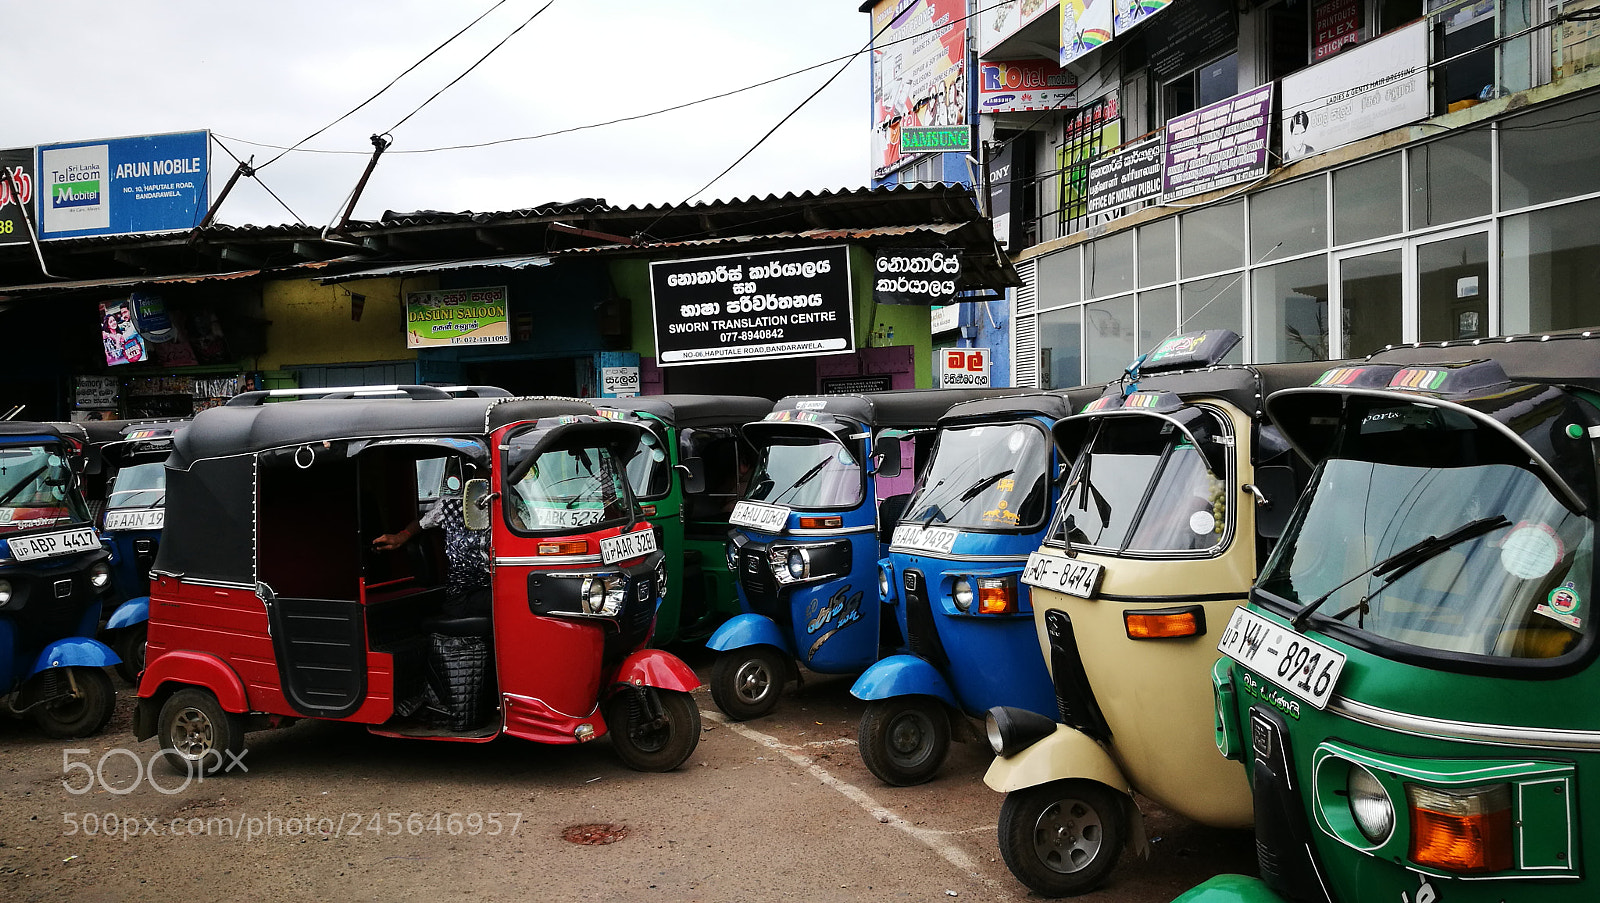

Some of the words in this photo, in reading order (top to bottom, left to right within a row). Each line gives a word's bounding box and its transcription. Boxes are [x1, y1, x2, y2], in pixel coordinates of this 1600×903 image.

[1317, 5, 1356, 30] PRINTOUTS
[1319, 19, 1354, 43] FLEX
[1318, 32, 1356, 57] STICKER
[1326, 92, 1345, 105] LADIES
[1350, 83, 1370, 96] GENTS
[1369, 77, 1386, 89] HAIR
[902, 130, 968, 148] SAMSUNG
[52, 168, 101, 183] Telecom
[80, 163, 100, 171] Lanka
[115, 161, 151, 180] ARUN
[153, 157, 201, 176] MOBILE
[990, 165, 1010, 183] ONY
[56, 186, 97, 205] Mobitel
[144, 183, 175, 192] HAPUTALE
[175, 182, 195, 190] ROAD,
[1089, 192, 1107, 213] OFFICE
[1107, 188, 1117, 205] OF
[1116, 182, 1138, 204] NOTARY
[1138, 176, 1161, 199] PUBLIC
[667, 264, 743, 287] නොතාරිස්
[748, 259, 831, 282] කාර්යාලය
[876, 252, 960, 274] නොතාරිස්
[732, 281, 757, 295] සහ
[875, 276, 956, 297] කාර්යාලය
[409, 308, 454, 323] DASUNI
[457, 305, 504, 320] SALOON
[680, 300, 720, 318] භාෂා
[726, 293, 823, 314] පරිවර්තනය
[668, 321, 709, 334] SWORN
[711, 314, 788, 331] TRANSLATION
[790, 310, 837, 325] CENTRE
[720, 328, 785, 343] 077-8940842
[119, 516, 144, 527] AAN
[545, 510, 566, 526] ABK
[742, 506, 761, 521] AAU
[761, 507, 787, 529] 0048
[16, 547, 29, 558] UP
[29, 537, 57, 554] ABP
[63, 532, 93, 547] 4417
[615, 538, 633, 556] AAR
[922, 530, 955, 550] 9492
[1059, 563, 1096, 592] 8474
[1222, 627, 1239, 649] UP
[1277, 641, 1336, 698] 8916
